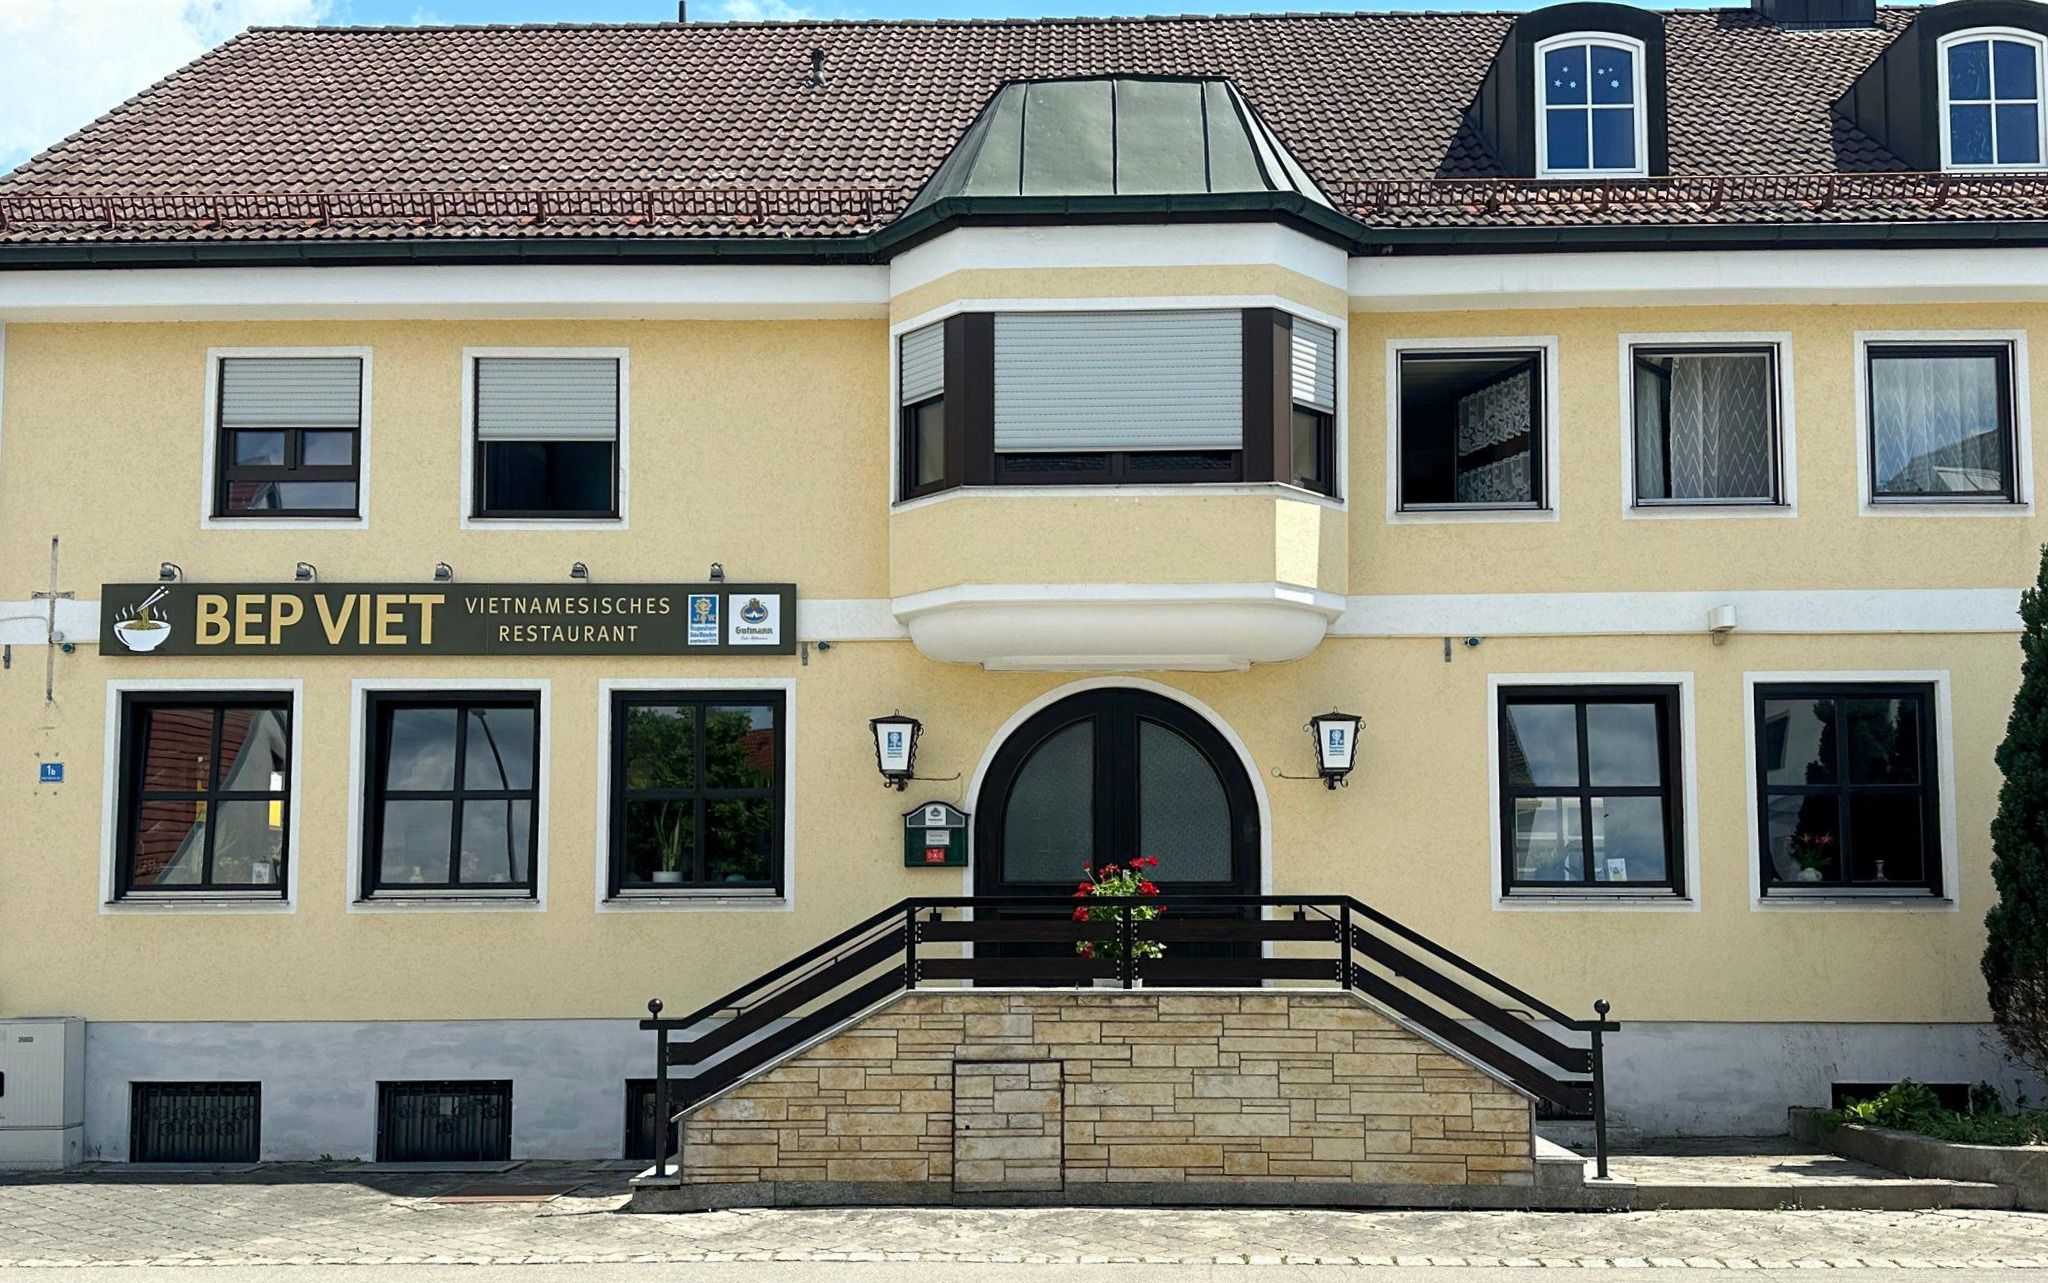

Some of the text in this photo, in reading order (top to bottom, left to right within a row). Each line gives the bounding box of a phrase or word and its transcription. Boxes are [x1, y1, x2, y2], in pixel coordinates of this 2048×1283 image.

[465, 597, 671, 614] VIETNAMESISCHES
[196, 594, 446, 645] BEP VIET
[499, 625, 639, 642] RESTAURANT
[735, 626, 773, 635] Gutmann
